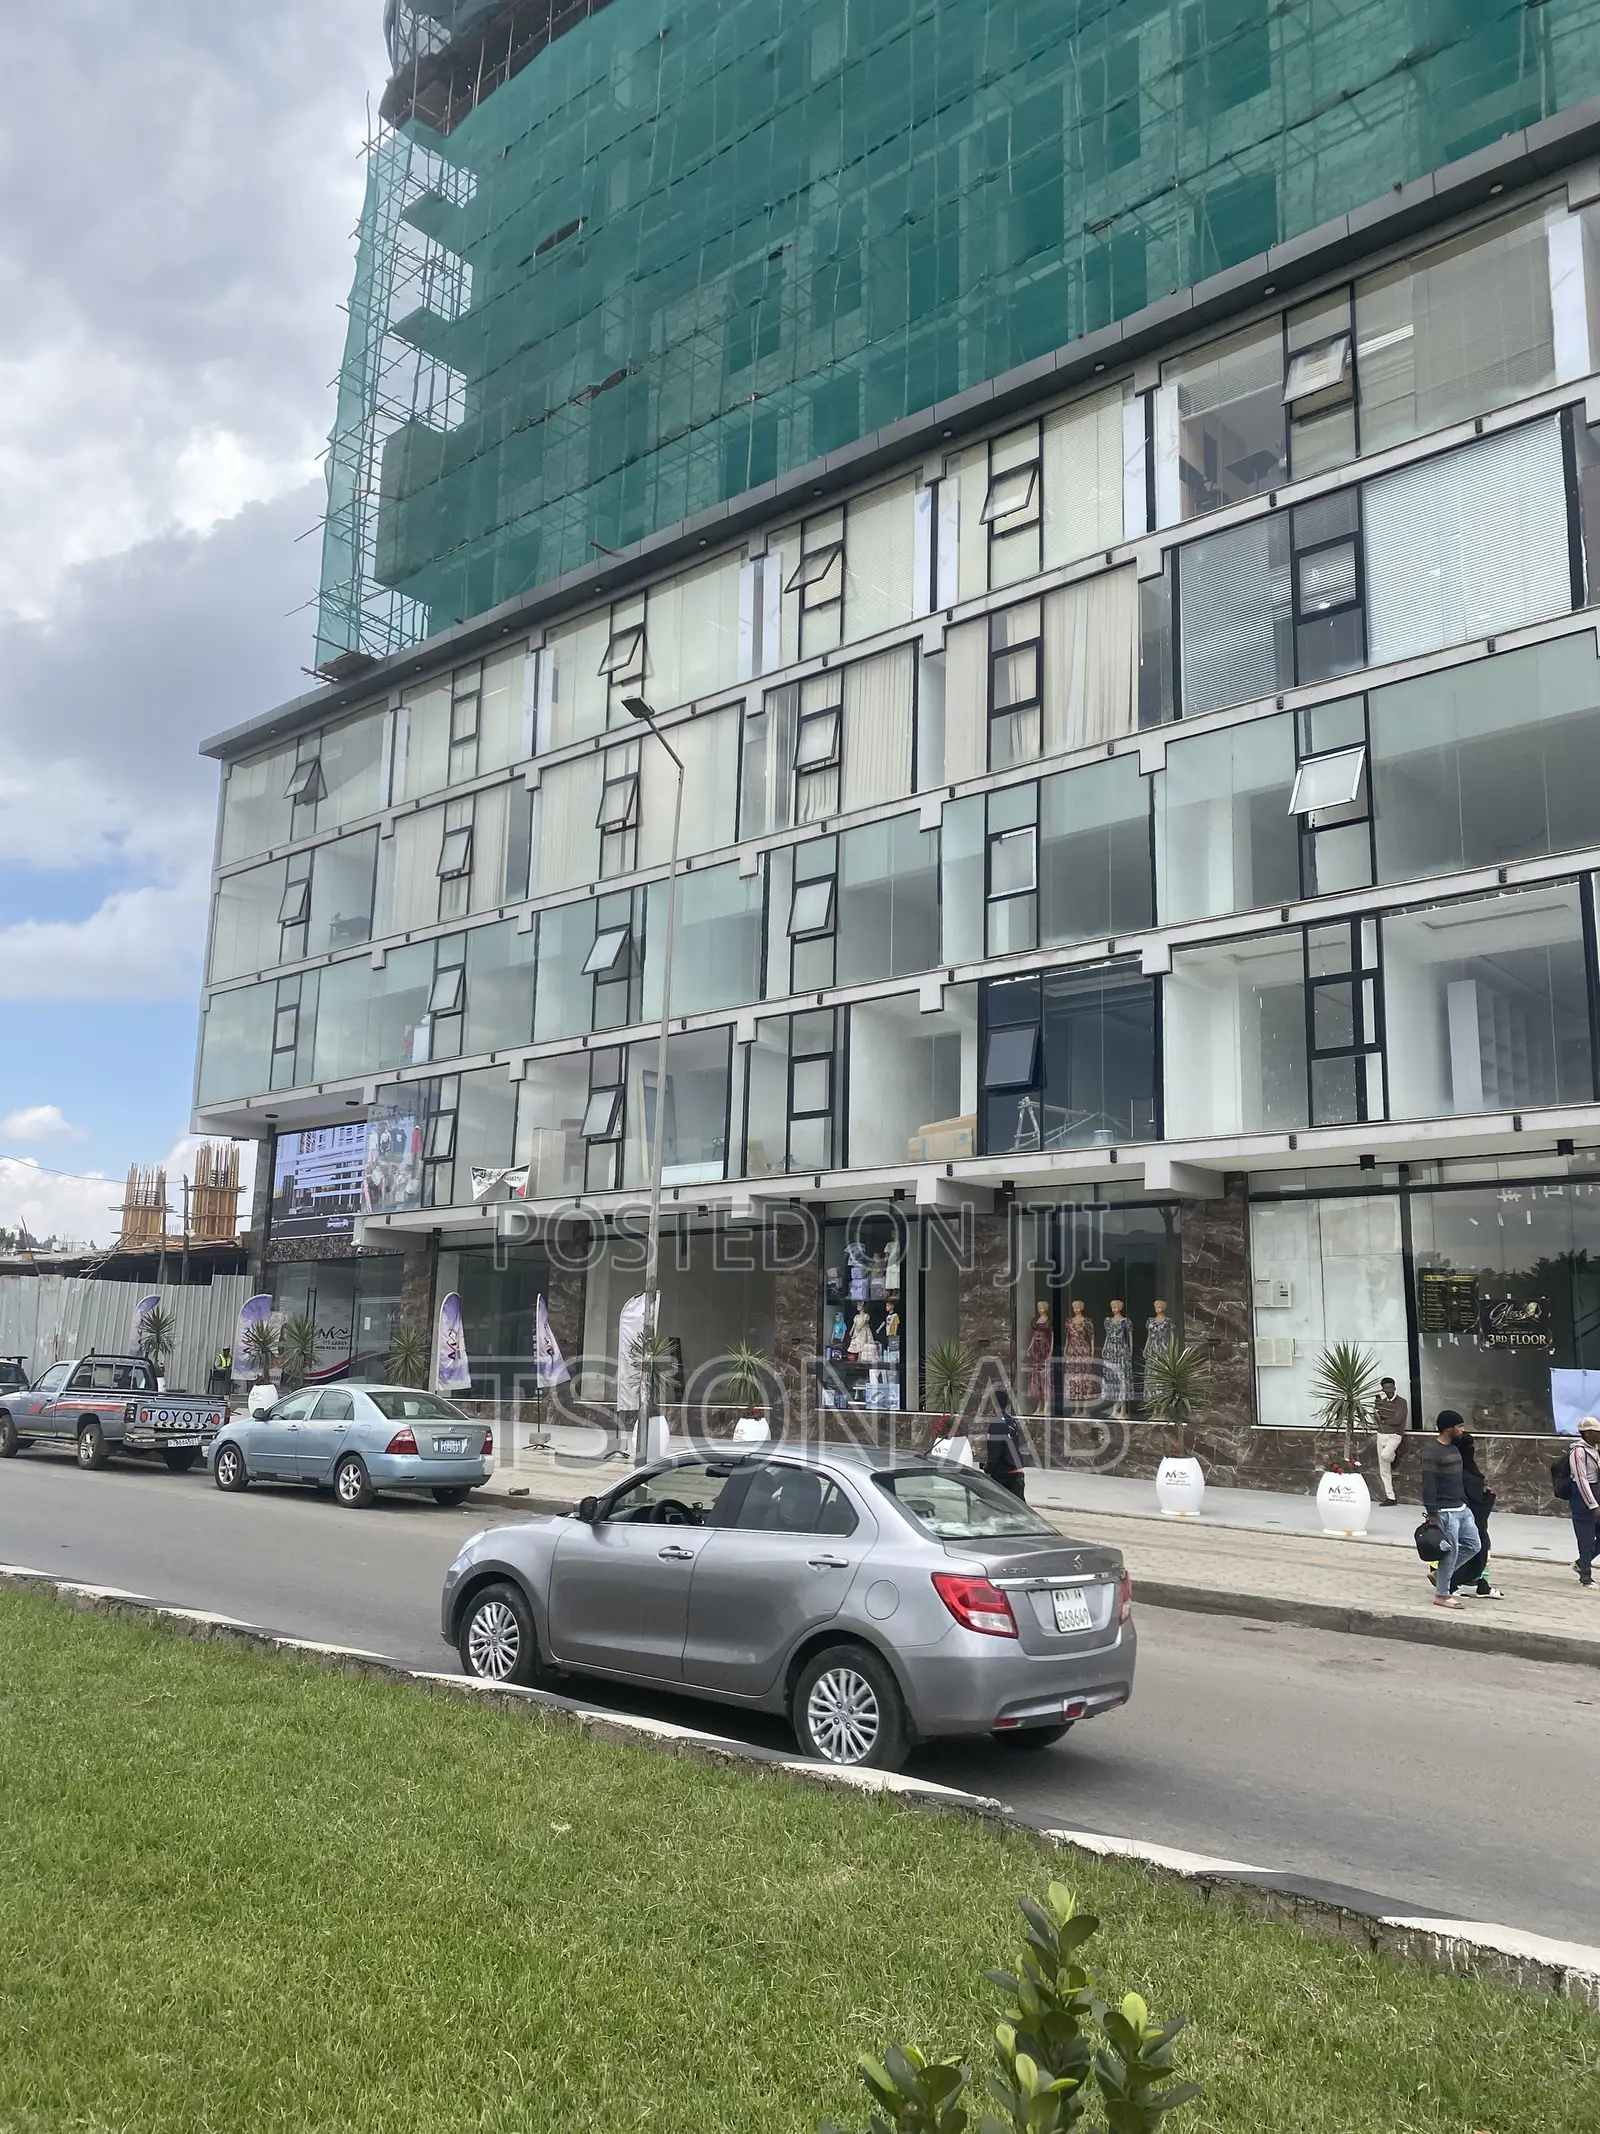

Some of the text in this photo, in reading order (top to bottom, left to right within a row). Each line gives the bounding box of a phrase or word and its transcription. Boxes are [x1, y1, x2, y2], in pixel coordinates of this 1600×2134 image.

[1487, 1333, 1547, 1346] 3RD FLOOR
[147, 1409, 214, 1424] TOYOTA
[1057, 1608, 1090, 1630] B68649
